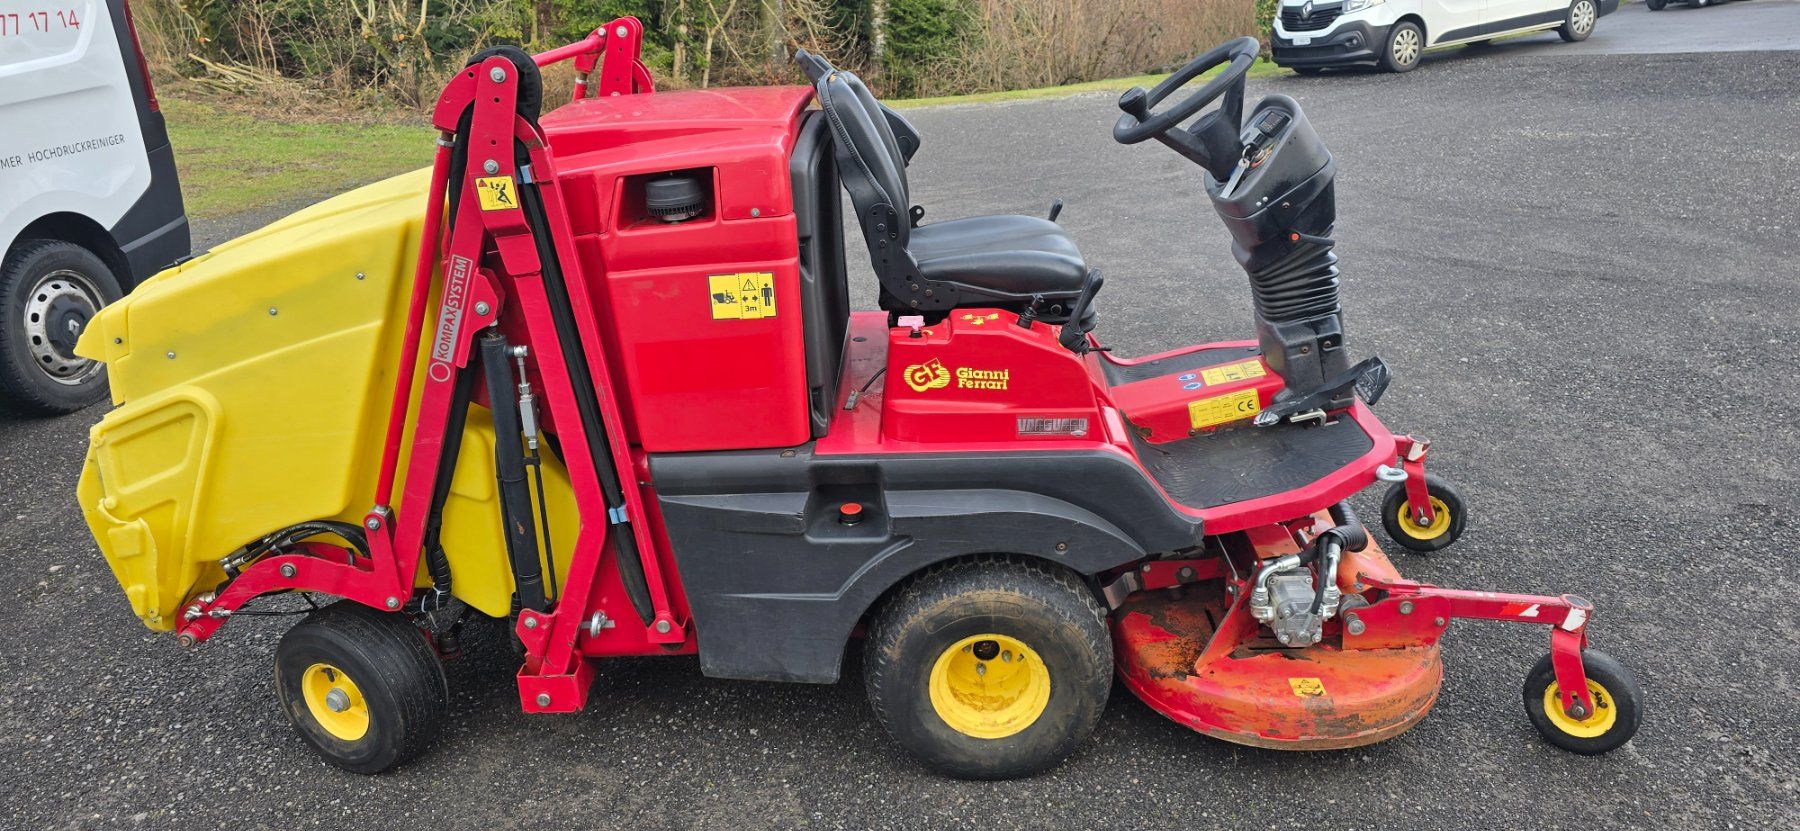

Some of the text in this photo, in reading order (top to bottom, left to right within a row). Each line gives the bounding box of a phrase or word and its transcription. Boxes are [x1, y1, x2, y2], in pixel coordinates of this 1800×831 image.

[29, 11, 48, 33] 17
[57, 9, 80, 29] 14
[0, 134, 126, 169] MER HOCHDRUCKREINIGER
[437, 259, 469, 359] KOMPAX SYSTEM
[909, 357, 942, 388] GF
[956, 367, 1009, 380] Gianni
[957, 378, 1008, 390] Ferrari
[1017, 417, 1089, 433] VANGUARD
